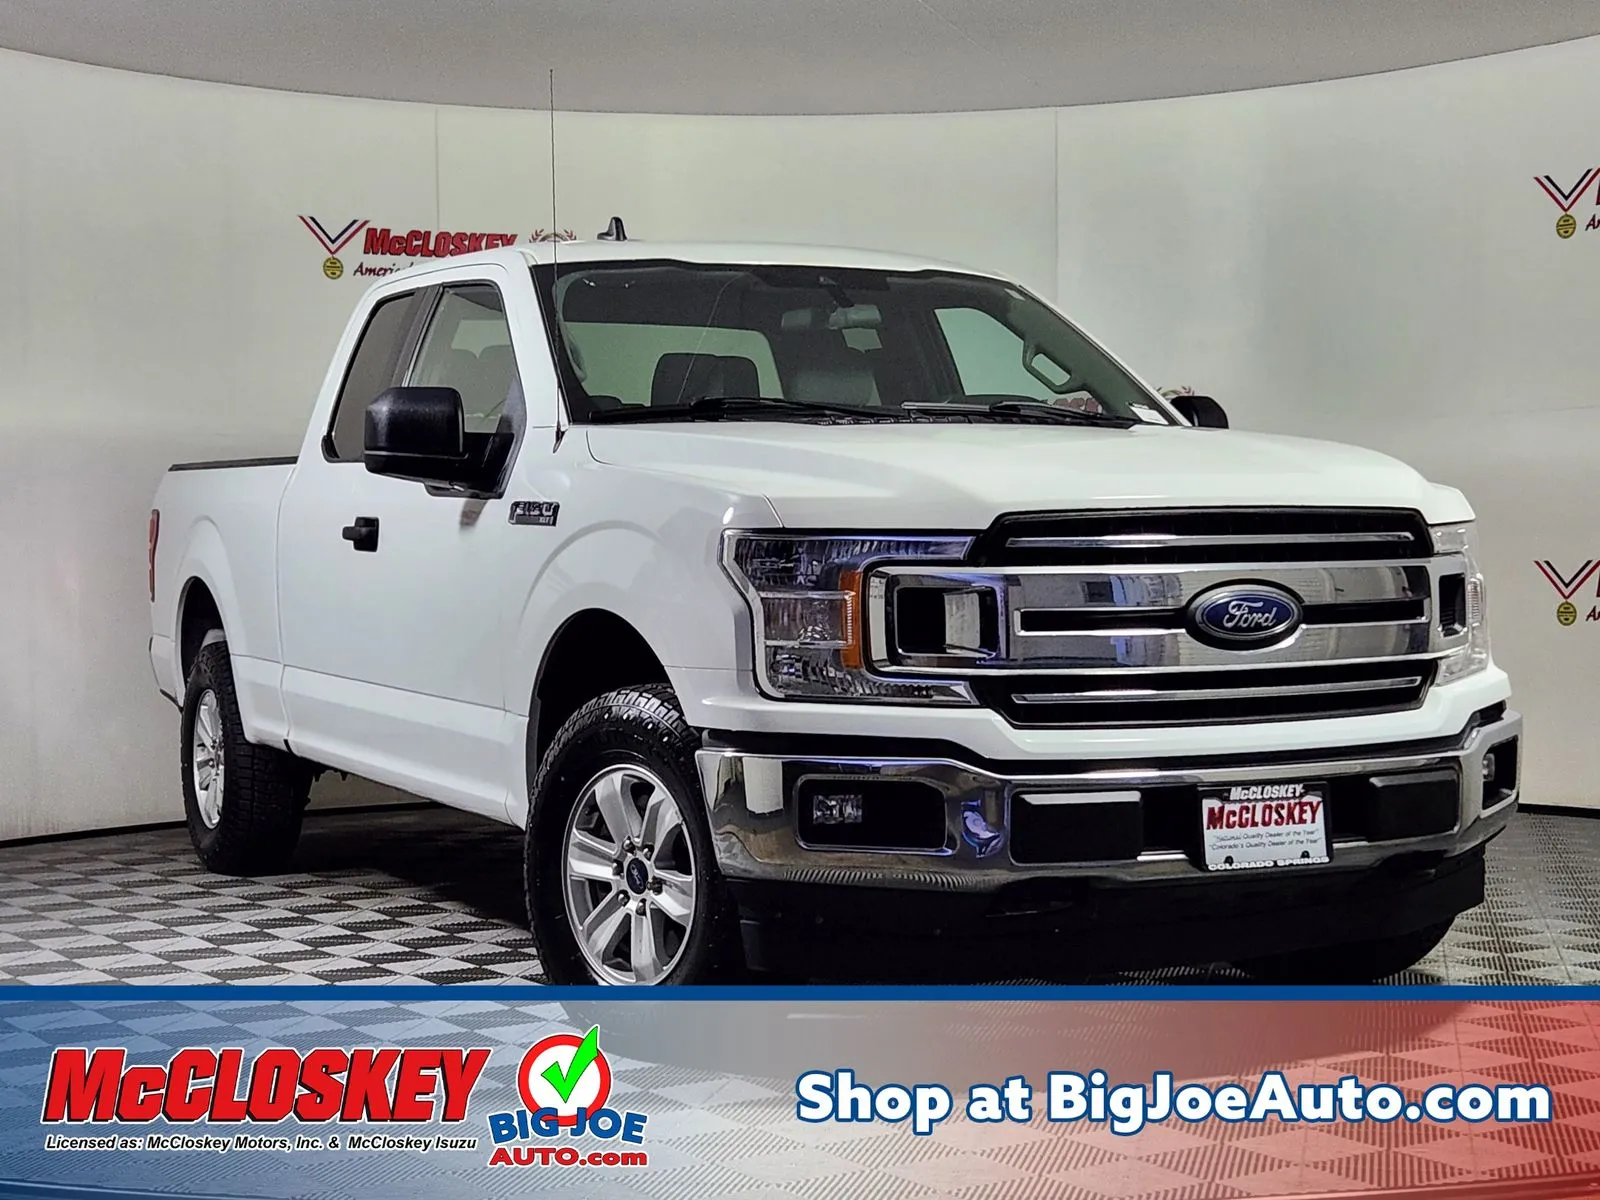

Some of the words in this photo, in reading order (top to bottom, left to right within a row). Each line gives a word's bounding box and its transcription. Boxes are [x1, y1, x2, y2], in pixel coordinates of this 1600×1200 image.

[364, 228, 518, 258] McCLOSKEY
[1223, 600, 1278, 628] Ford
[1229, 784, 1303, 801] McCLOSKEY
[1206, 800, 1322, 830] McCLOSKEY
[1208, 859, 1275, 871] COLORADO
[1276, 856, 1330, 867] SPRINGS
